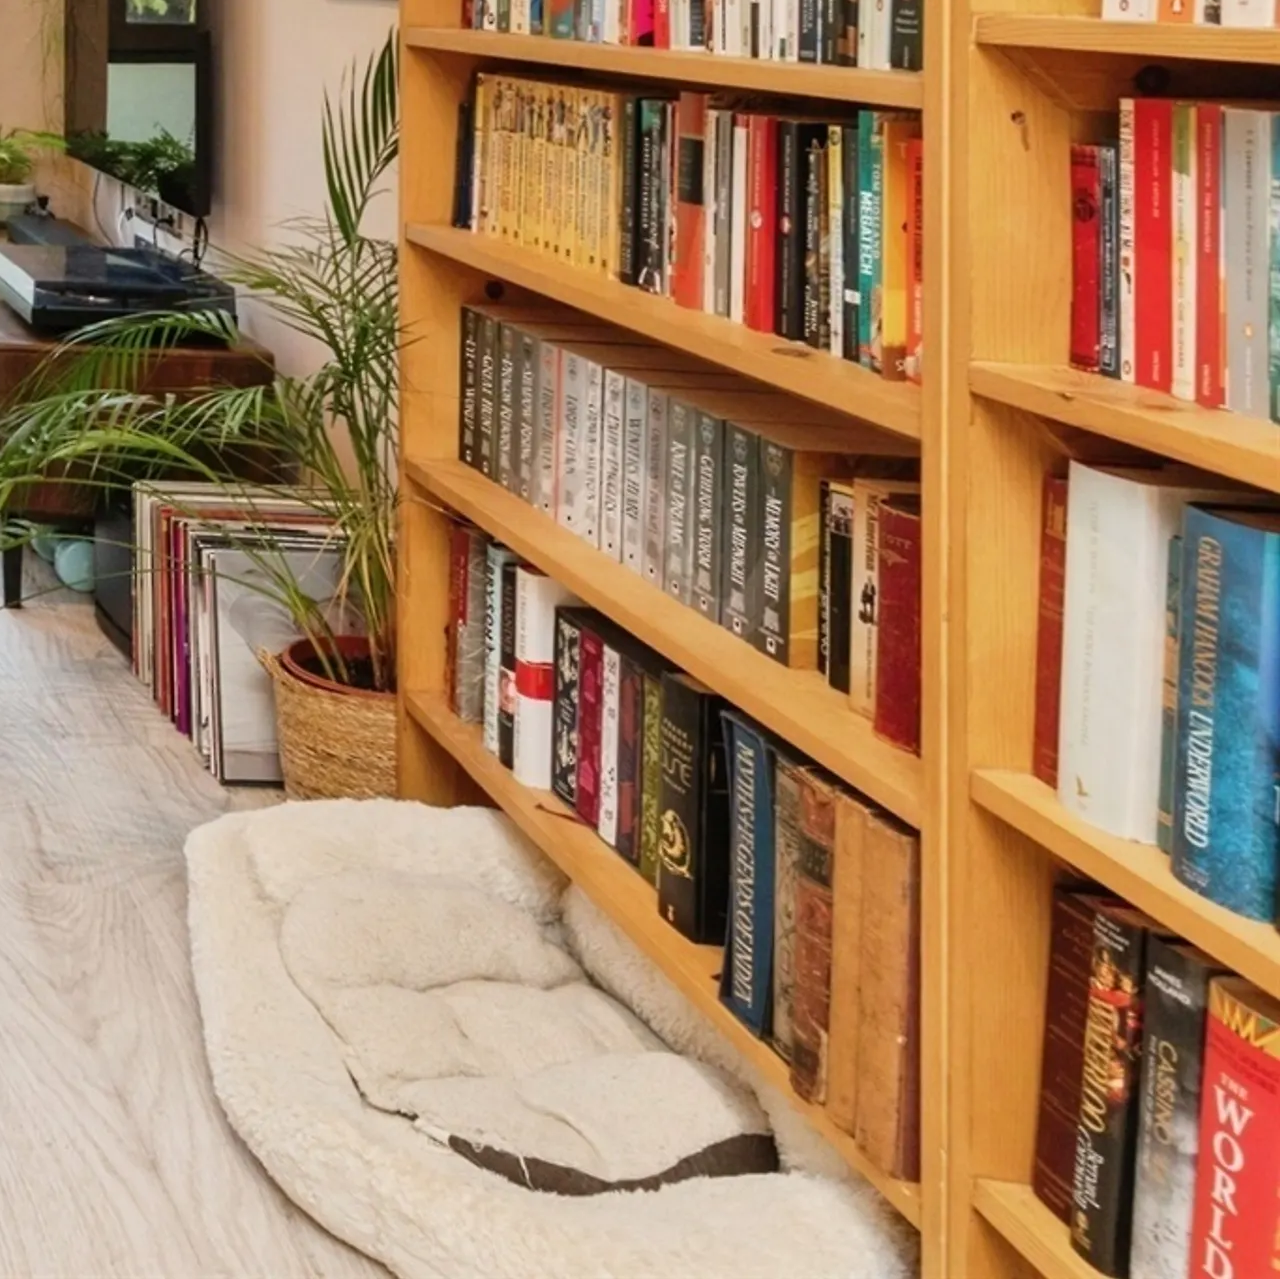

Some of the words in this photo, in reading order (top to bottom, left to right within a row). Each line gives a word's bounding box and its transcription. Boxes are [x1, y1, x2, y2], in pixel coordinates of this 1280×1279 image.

[872, 162, 882, 191] TOM
[860, 191, 873, 276] MEGATECH
[872, 195, 881, 260] HOLLAND
[463, 387, 477, 430] WORLD
[480, 397, 495, 436] HUNT
[670, 440, 687, 480] KNIFE
[698, 454, 715, 523] GATHERING
[731, 463, 748, 514] TOWERS
[626, 478, 641, 521] HEART
[670, 490, 685, 548] DREAMS
[765, 494, 782, 551] MEMORY
[698, 524, 712, 569] STORM
[730, 524, 747, 589] MIDNIGHT
[865, 513, 878, 572] American
[764, 561, 781, 602] LIGHT
[1195, 535, 1223, 619] GRAHAM
[503, 583, 514, 655] ALEXANDER
[1191, 620, 1220, 710] HANCOCK
[736, 741, 755, 821] MYTHS
[1184, 710, 1215, 850] UNDERWORLD
[733, 937, 754, 1009] INDIA
[1080, 998, 1115, 1133] WATERLOO
[1154, 1039, 1179, 1145] CASSINO
[1200, 1083, 1257, 1279] WORLD
